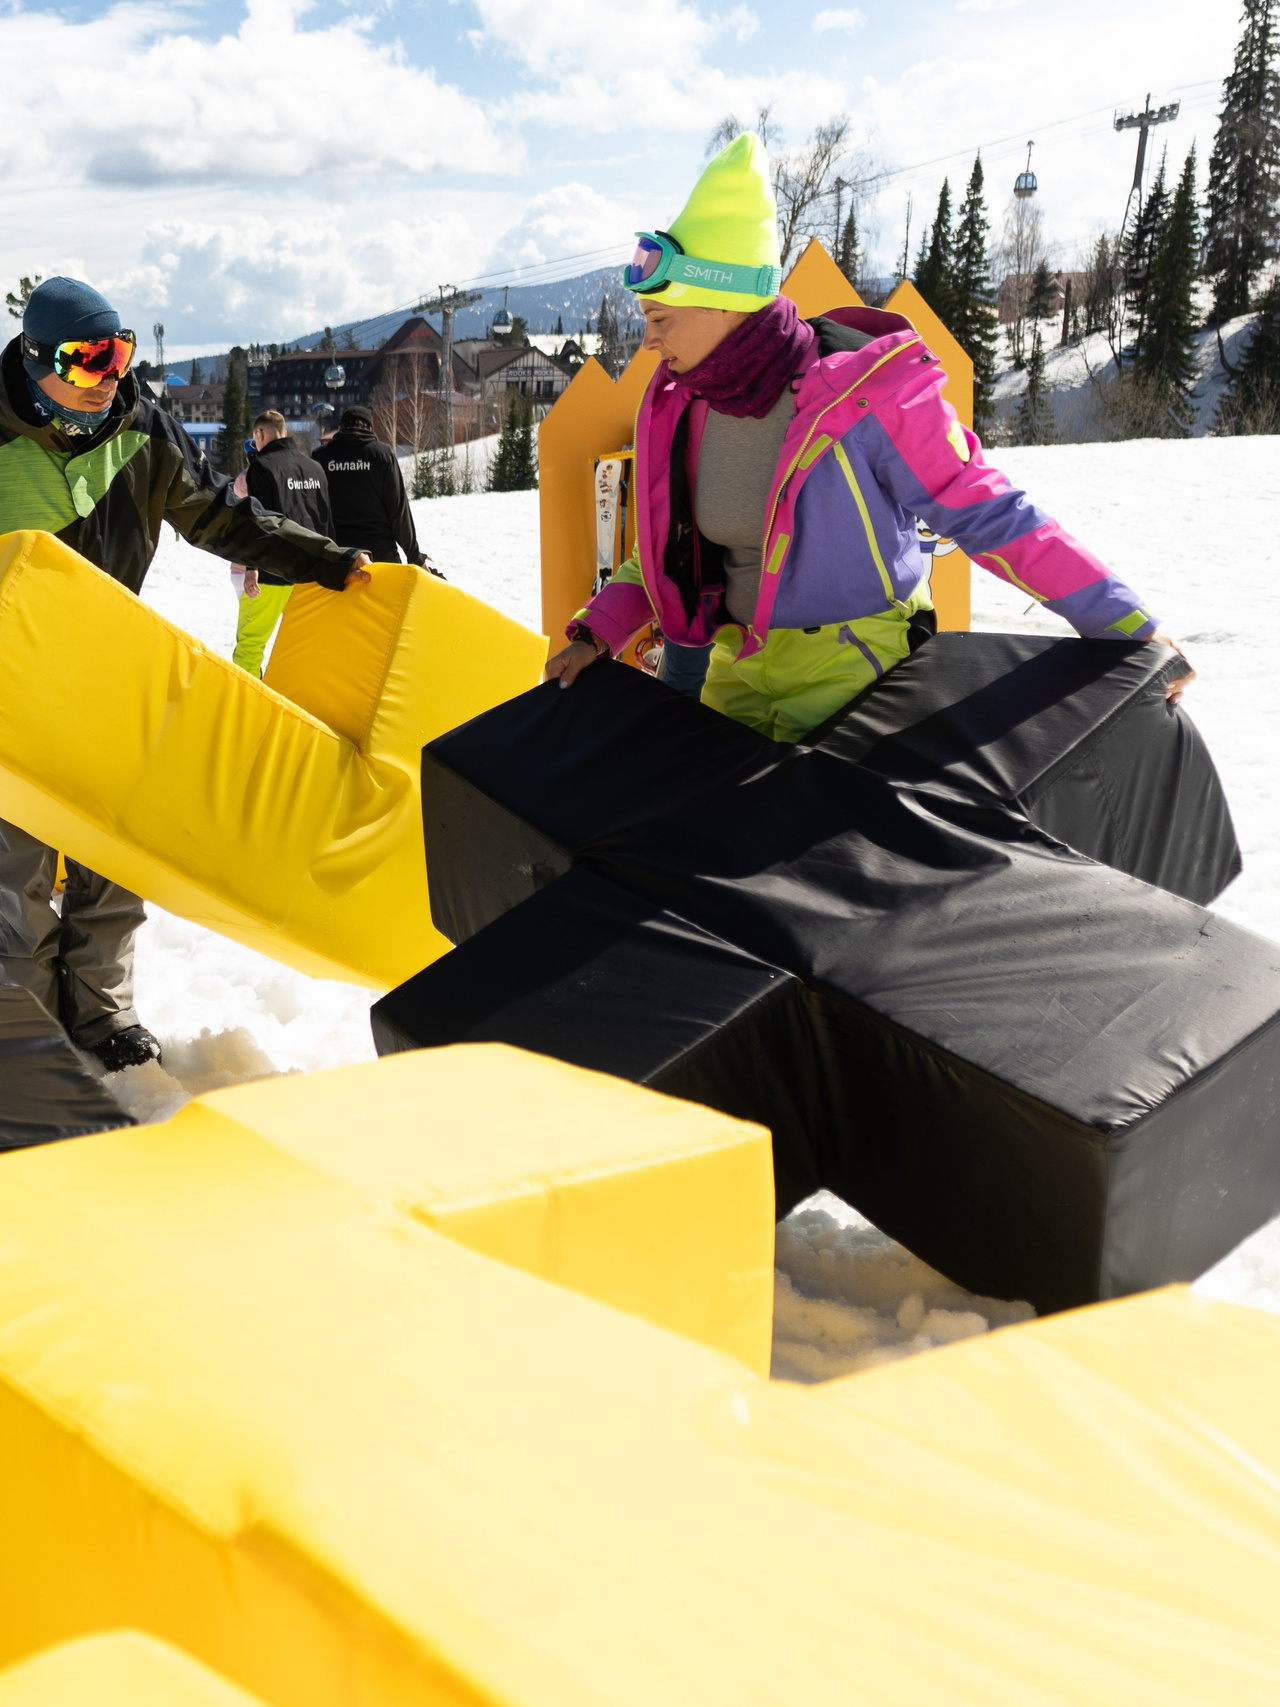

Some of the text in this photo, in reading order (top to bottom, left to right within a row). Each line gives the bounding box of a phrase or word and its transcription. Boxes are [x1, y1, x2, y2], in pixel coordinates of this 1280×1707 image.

[683, 265, 733, 284] SMITH
[328, 460, 370, 471] билайн
[287, 477, 321, 490] билайн
